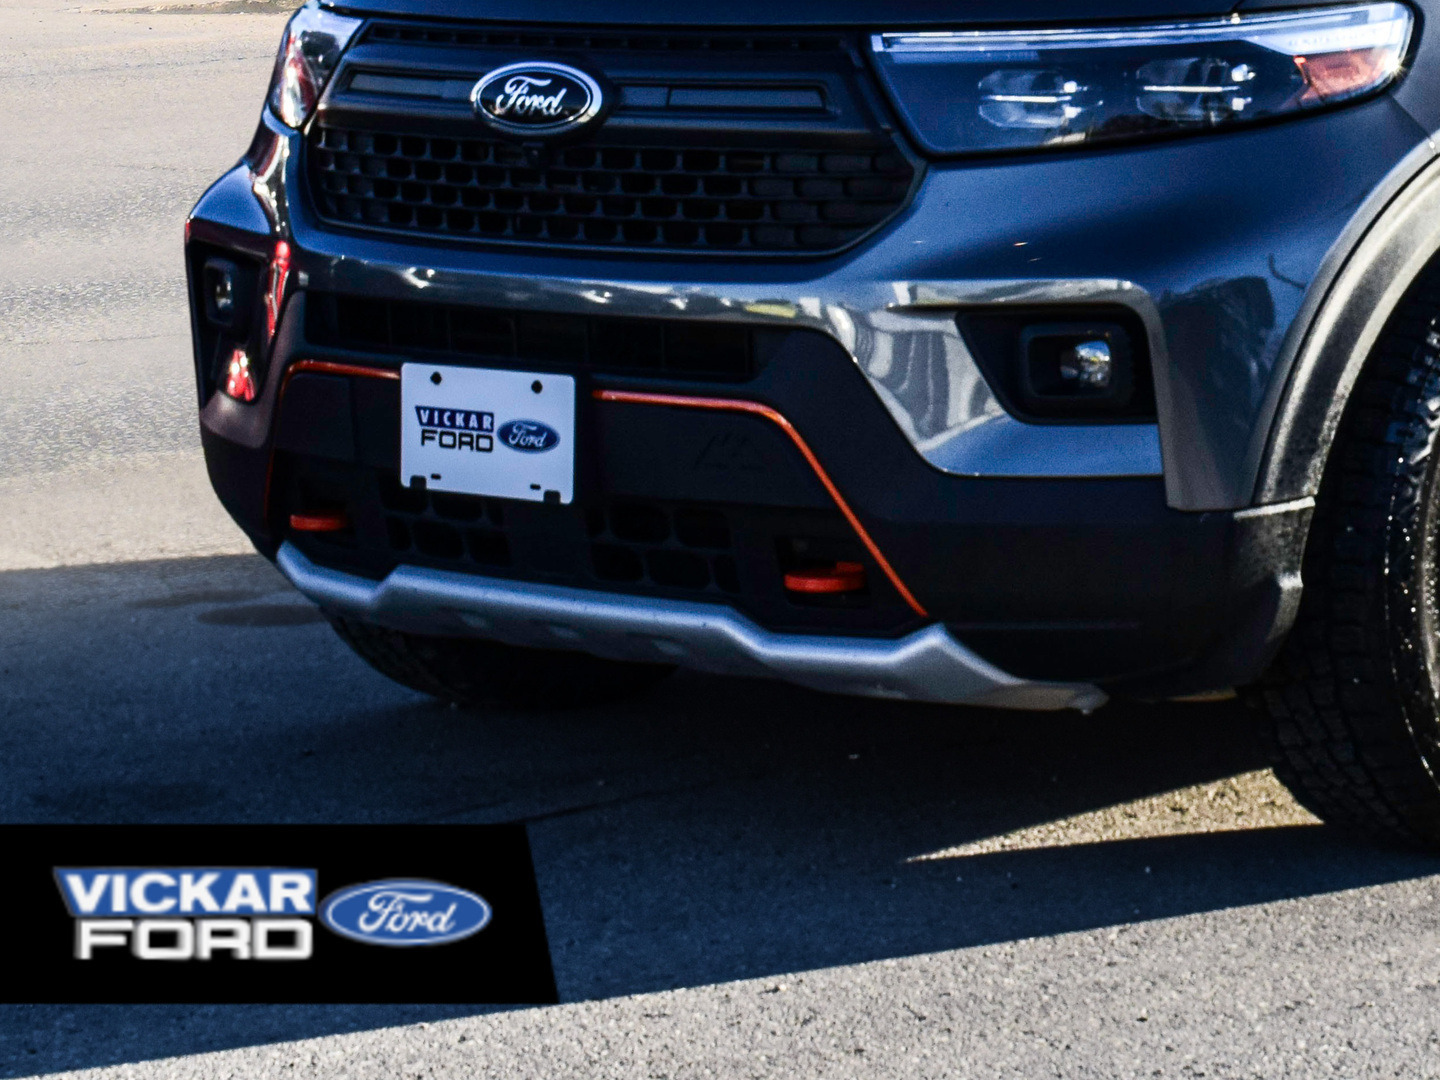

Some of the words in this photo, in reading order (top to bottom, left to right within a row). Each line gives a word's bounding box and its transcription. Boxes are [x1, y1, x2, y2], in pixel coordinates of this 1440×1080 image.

[495, 75, 568, 116] Ford
[419, 408, 493, 431] VICKAR
[421, 428, 494, 454] FORD
[508, 423, 548, 448] Ford
